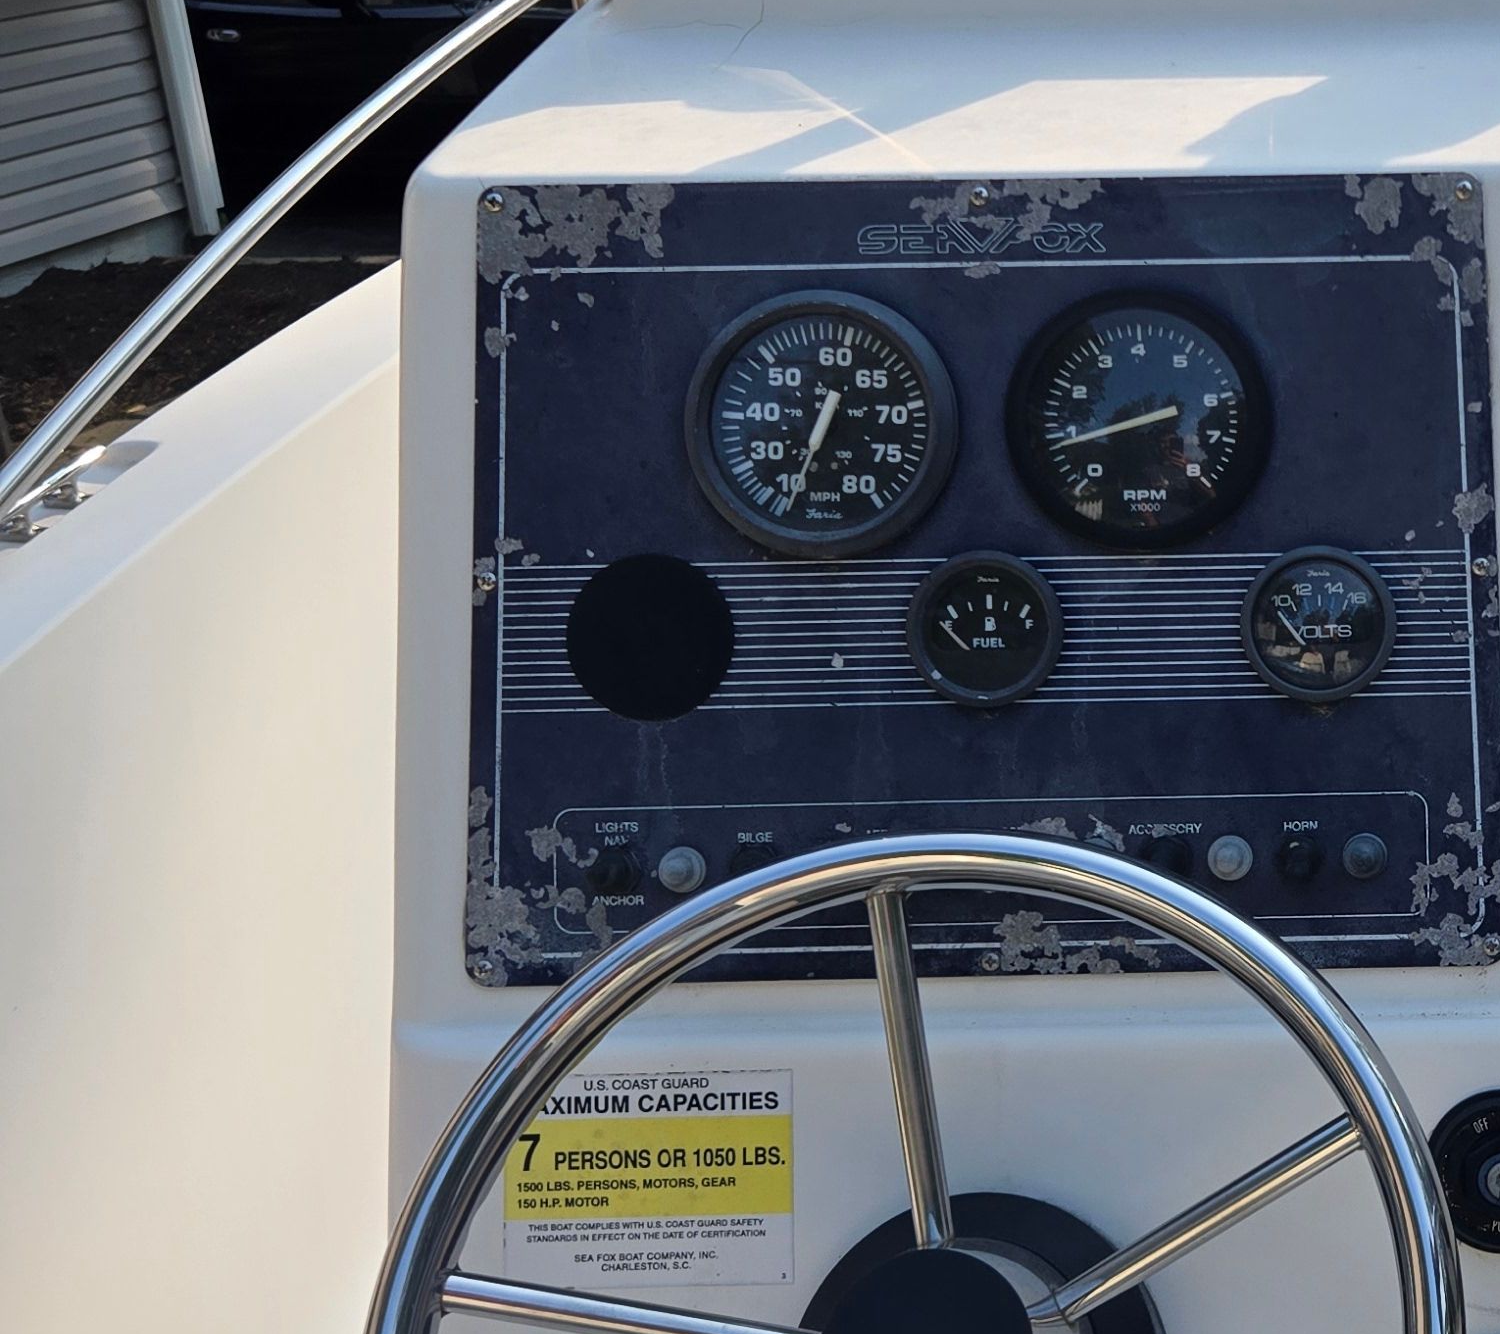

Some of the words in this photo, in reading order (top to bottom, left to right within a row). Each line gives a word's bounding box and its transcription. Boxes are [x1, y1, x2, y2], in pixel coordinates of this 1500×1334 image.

[819, 347, 852, 367] 60
[1131, 343, 1146, 357] 4
[1098, 355, 1113, 368] 3
[1173, 355, 1188, 368] 5
[768, 367, 801, 386] 50
[856, 370, 888, 389] 65
[1072, 386, 1087, 399] 2
[1204, 394, 1219, 407] 6
[746, 402, 780, 421] 40
[875, 405, 908, 424] 70
[1066, 425, 1077, 439] 1
[1206, 430, 1221, 443] 7
[751, 441, 784, 460] 30
[871, 444, 902, 463] 75
[1087, 464, 1103, 477] 0
[1186, 464, 1201, 477] 8
[776, 473, 806, 493] 10
[842, 475, 876, 494] 80
[809, 492, 841, 502] MPH
[1123, 489, 1167, 501] RPM
[1271, 595, 1292, 607] 10
[1291, 583, 1312, 596] 12
[1324, 582, 1344, 595] 14
[1347, 592, 1367, 604] 16
[945, 620, 953, 631] E
[1025, 619, 1034, 630] F
[1297, 624, 1352, 638] VOLTS
[972, 637, 1006, 648] FUEL
[595, 821, 639, 833] LIGHTS
[1128, 822, 1202, 835] ACCSORY
[1283, 820, 1318, 831] HORN
[737, 832, 773, 843] BILGE
[592, 895, 644, 906] ANCHOR
[584, 1079, 609, 1091] U.S.
[612, 1078, 658, 1091] COAST
[661, 1077, 709, 1089] GUARD
[540, 1094, 629, 1115] XIMUM
[638, 1091, 779, 1113] CAPACITIES
[1472, 1117, 1489, 1134] OFF
[518, 1133, 541, 1171] 7
[554, 1149, 651, 1170] PERSONS
[657, 1148, 686, 1168] OR
[693, 1147, 736, 1167] 1050
[742, 1146, 785, 1166] LBS.
[517, 1182, 543, 1193] 1500
[546, 1181, 574, 1192] LBS.
[577, 1179, 640, 1191] PERSONS,
[642, 1177, 699, 1189] MOTORS,
[701, 1176, 736, 1187] GEAR
[517, 1199, 536, 1209] 150
[540, 1198, 562, 1208] H.P.
[565, 1196, 609, 1207] MOTOR
[528, 1223, 549, 1232] THIS
[550, 1223, 573, 1231] BOAT
[575, 1221, 620, 1230] COMPLIES
[621, 1221, 644, 1229] WITH
[646, 1220, 662, 1229] U.S.
[665, 1219, 695, 1228] COAST
[697, 1219, 728, 1227] GUARD
[730, 1218, 764, 1227] SAFETY
[526, 1234, 578, 1243] STANDARDS
[580, 1233, 589, 1242] IN
[592, 1233, 626, 1242] EFFECT
[627, 1232, 641, 1240] ON
[642, 1231, 660, 1240] THE
[662, 1231, 684, 1239] DATE
[686, 1230, 699, 1239] OF
[700, 1229, 766, 1238] CERTIFICATION
[574, 1254, 594, 1263] SEA
[596, 1253, 616, 1262] FOX
[618, 1252, 644, 1261] BOAT
[646, 1251, 696, 1260] COMPANY,
[698, 1250, 719, 1259] INC.
[601, 1262, 670, 1271] CHARLESTON,
[672, 1261, 692, 1269] S.C.
